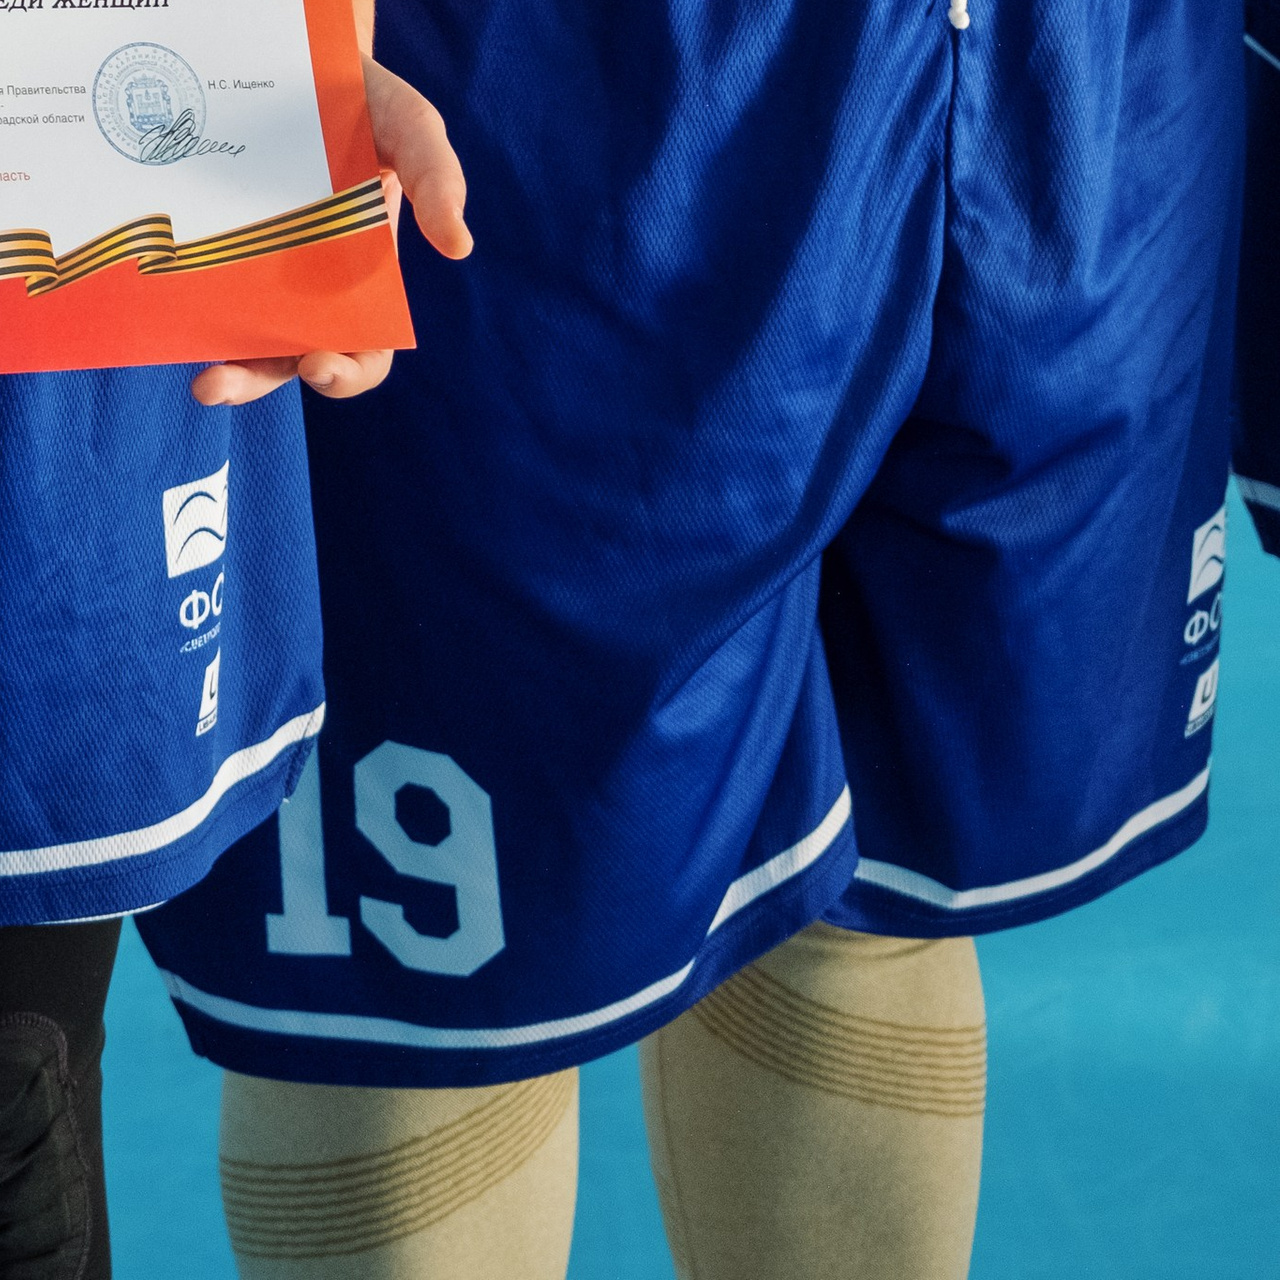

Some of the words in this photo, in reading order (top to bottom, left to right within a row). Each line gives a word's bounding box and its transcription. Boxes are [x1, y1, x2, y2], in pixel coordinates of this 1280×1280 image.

[6, 85, 86, 97] Правительства
[208, 80, 230, 91] Н.С.
[233, 79, 275, 91] Ищенко
[42, 113, 85, 124] области
[266, 739, 506, 977] 19
